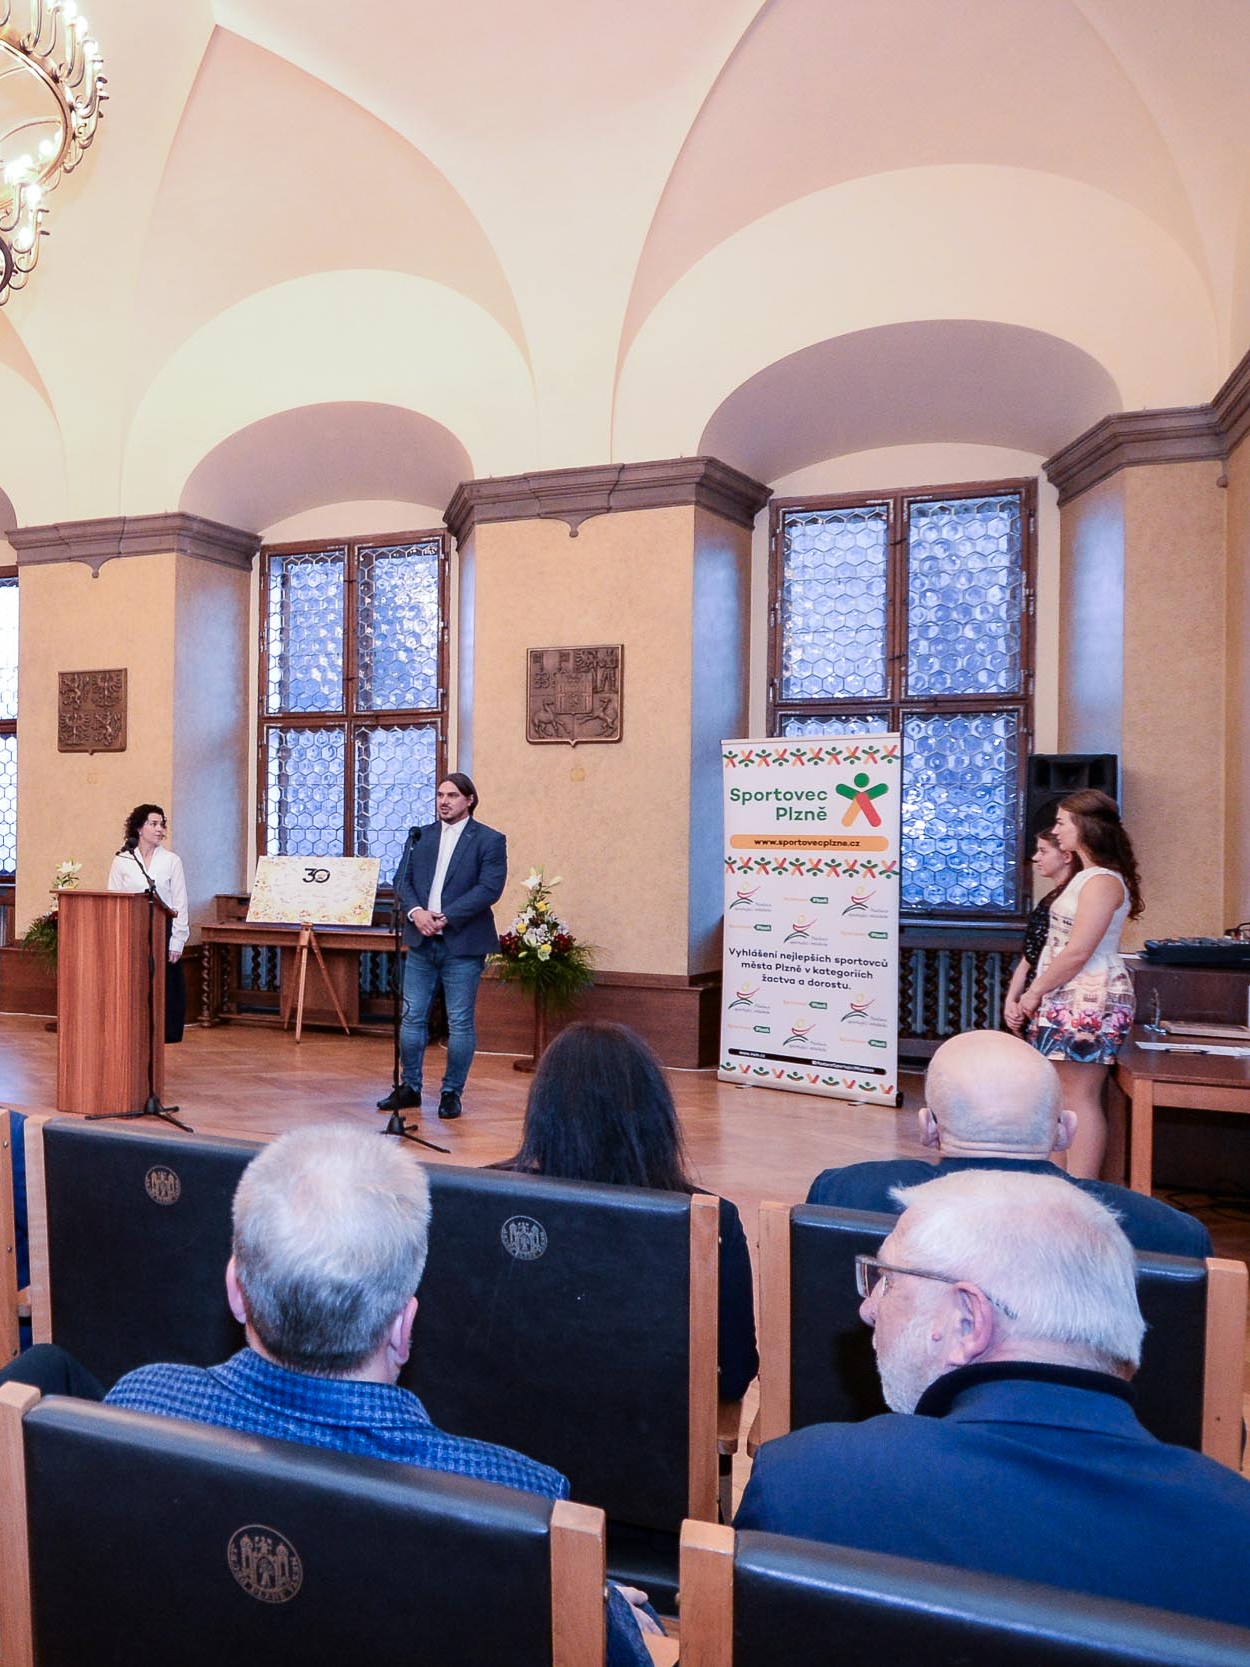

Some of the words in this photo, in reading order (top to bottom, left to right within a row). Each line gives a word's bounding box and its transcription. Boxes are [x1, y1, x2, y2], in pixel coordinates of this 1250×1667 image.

[730, 788, 828, 805] Sportovec
[776, 806, 828, 821] Plzně
[754, 838, 861, 848] www.sportovecplzne.cz
[302, 868, 331, 884] 30
[729, 948, 778, 960] Vyhlášení
[780, 952, 832, 964] nejlepších
[834, 956, 889, 968] sportovců
[741, 961, 773, 971] města
[775, 963, 802, 973] Plzně
[813, 966, 873, 980] kategoriích
[762, 974, 796, 985] žactva
[808, 977, 852, 990] dorostu.
